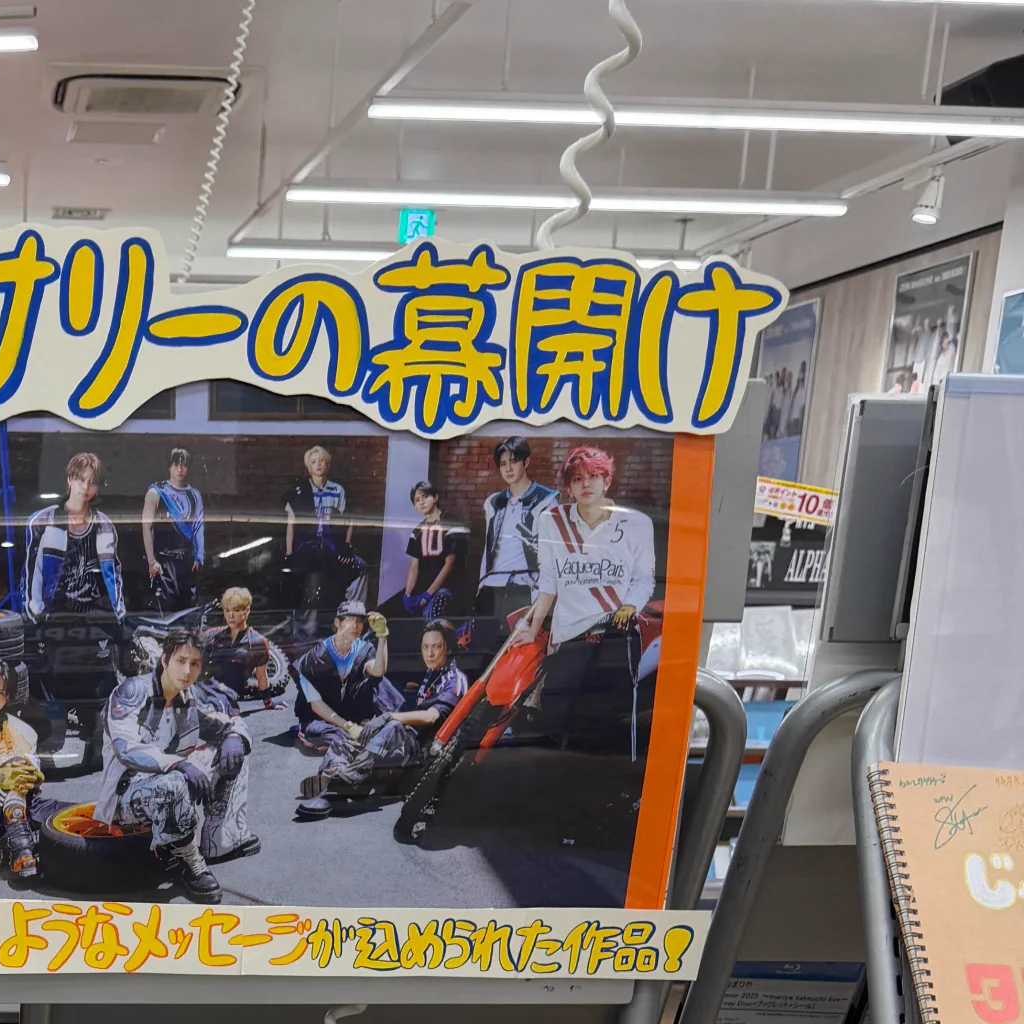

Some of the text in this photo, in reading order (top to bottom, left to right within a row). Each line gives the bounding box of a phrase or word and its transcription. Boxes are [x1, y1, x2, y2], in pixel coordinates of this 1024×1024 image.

[797, 493, 820, 514] 10
[421, 525, 443, 557] 10
[610, 519, 627, 543] 5
